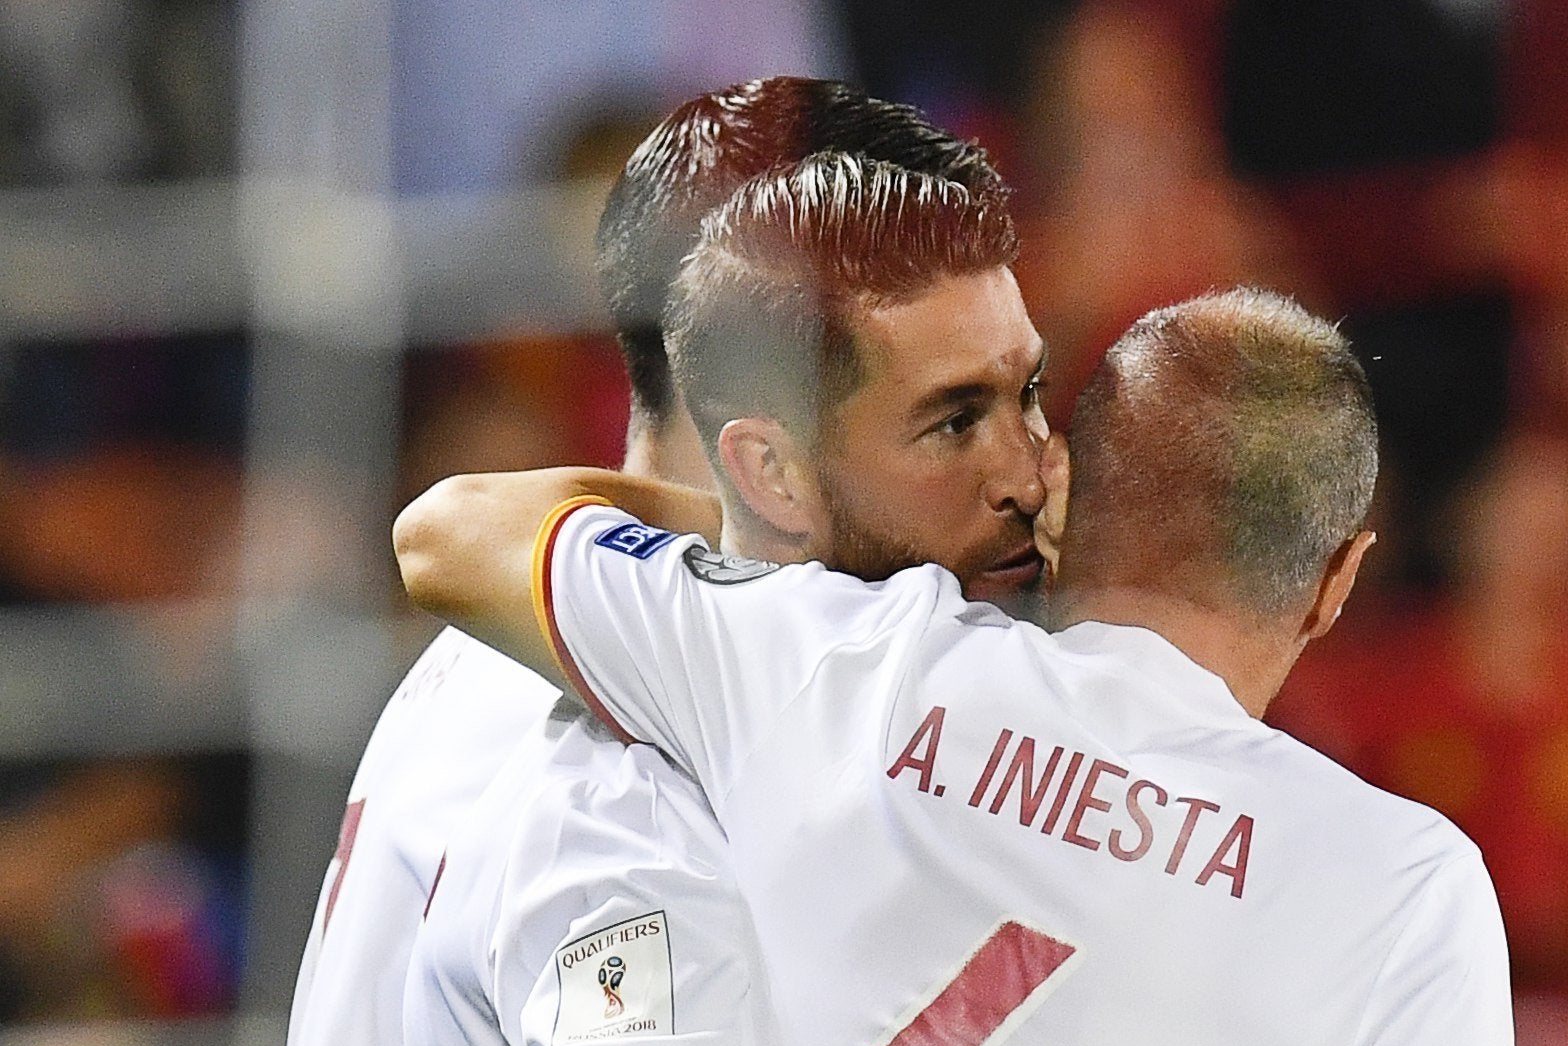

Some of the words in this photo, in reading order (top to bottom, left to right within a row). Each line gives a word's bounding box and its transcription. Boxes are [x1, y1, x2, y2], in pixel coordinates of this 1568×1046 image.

[886, 706, 946, 797] A.
[968, 728, 1254, 899] INIESTA
[562, 920, 660, 968] QUALIFIERS
[624, 1019, 657, 1033] 2018
